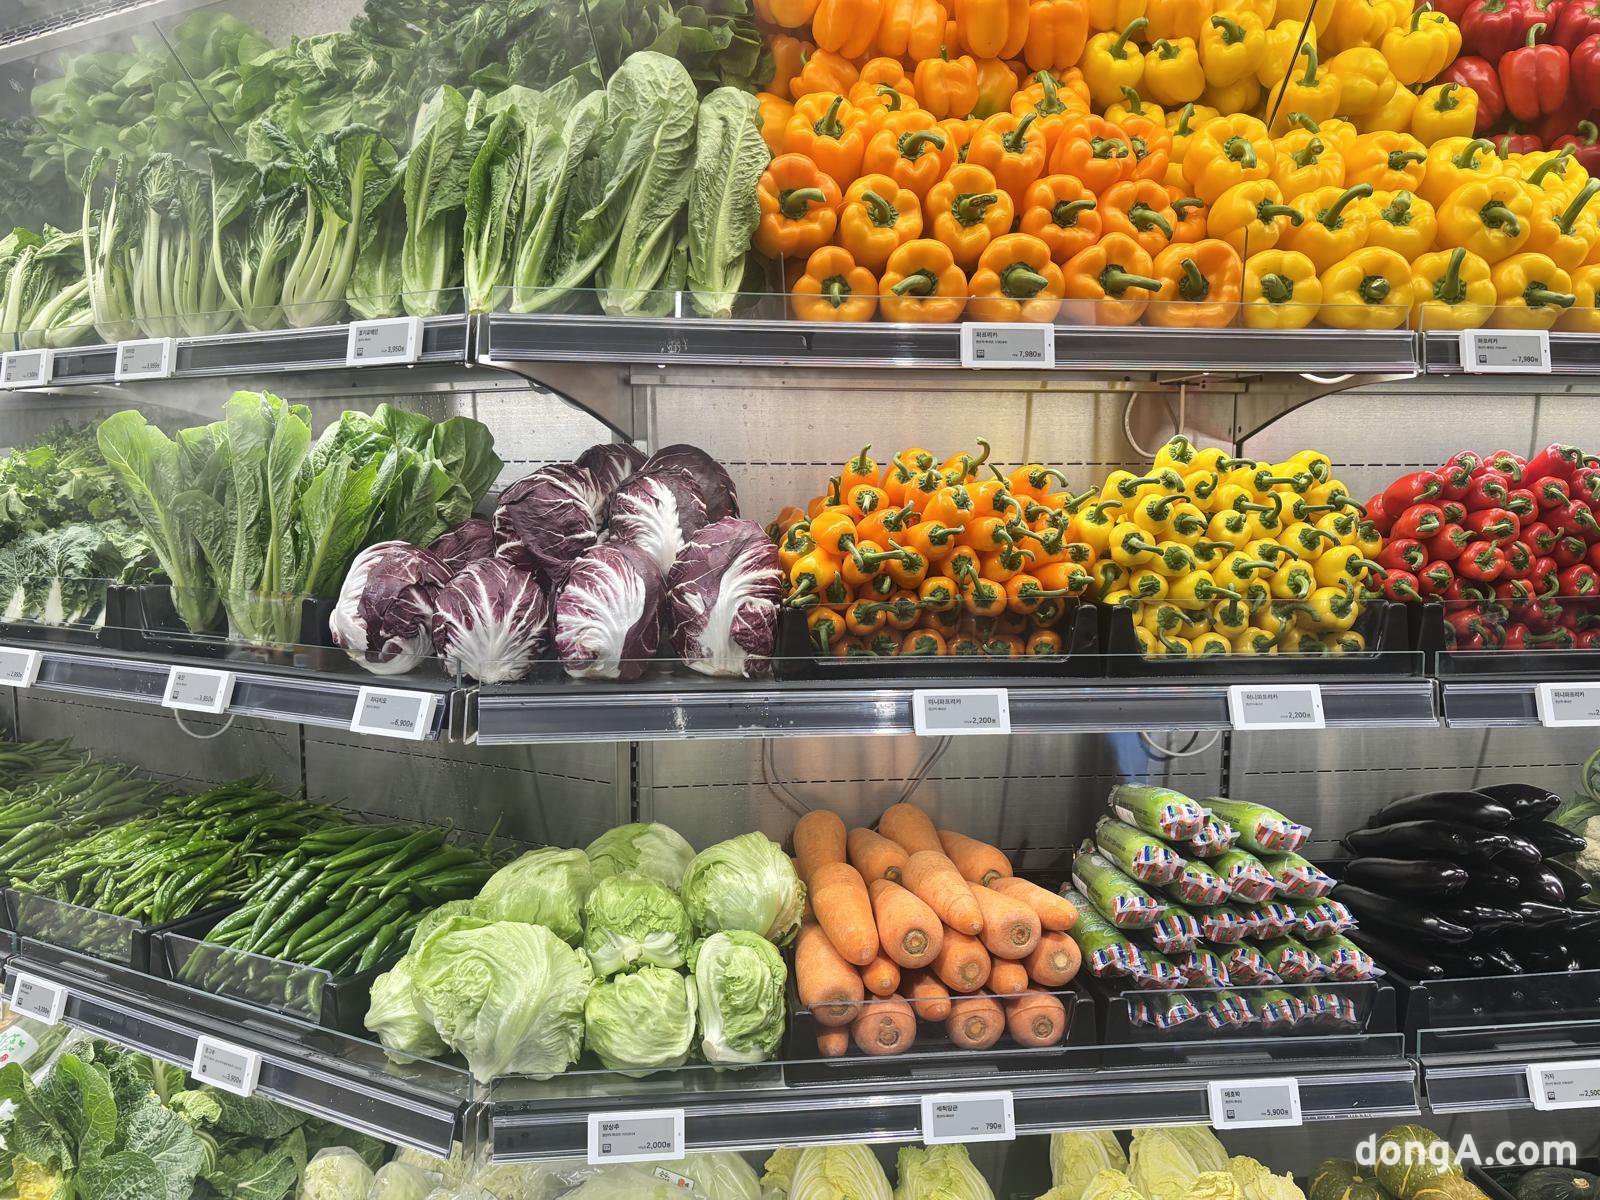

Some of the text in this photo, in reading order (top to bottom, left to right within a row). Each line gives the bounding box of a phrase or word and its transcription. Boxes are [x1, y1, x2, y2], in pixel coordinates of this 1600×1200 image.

[1288, 711, 1311, 719] 2,200원
[972, 716, 996, 725] 2,200원
[936, 1104, 958, 1112] 세척당근
[1266, 1108, 1288, 1117] 5,900원
[602, 1123, 619, 1131] 양상추
[985, 1122, 1002, 1130] 790원
[646, 1141, 671, 1150] 2,000원
